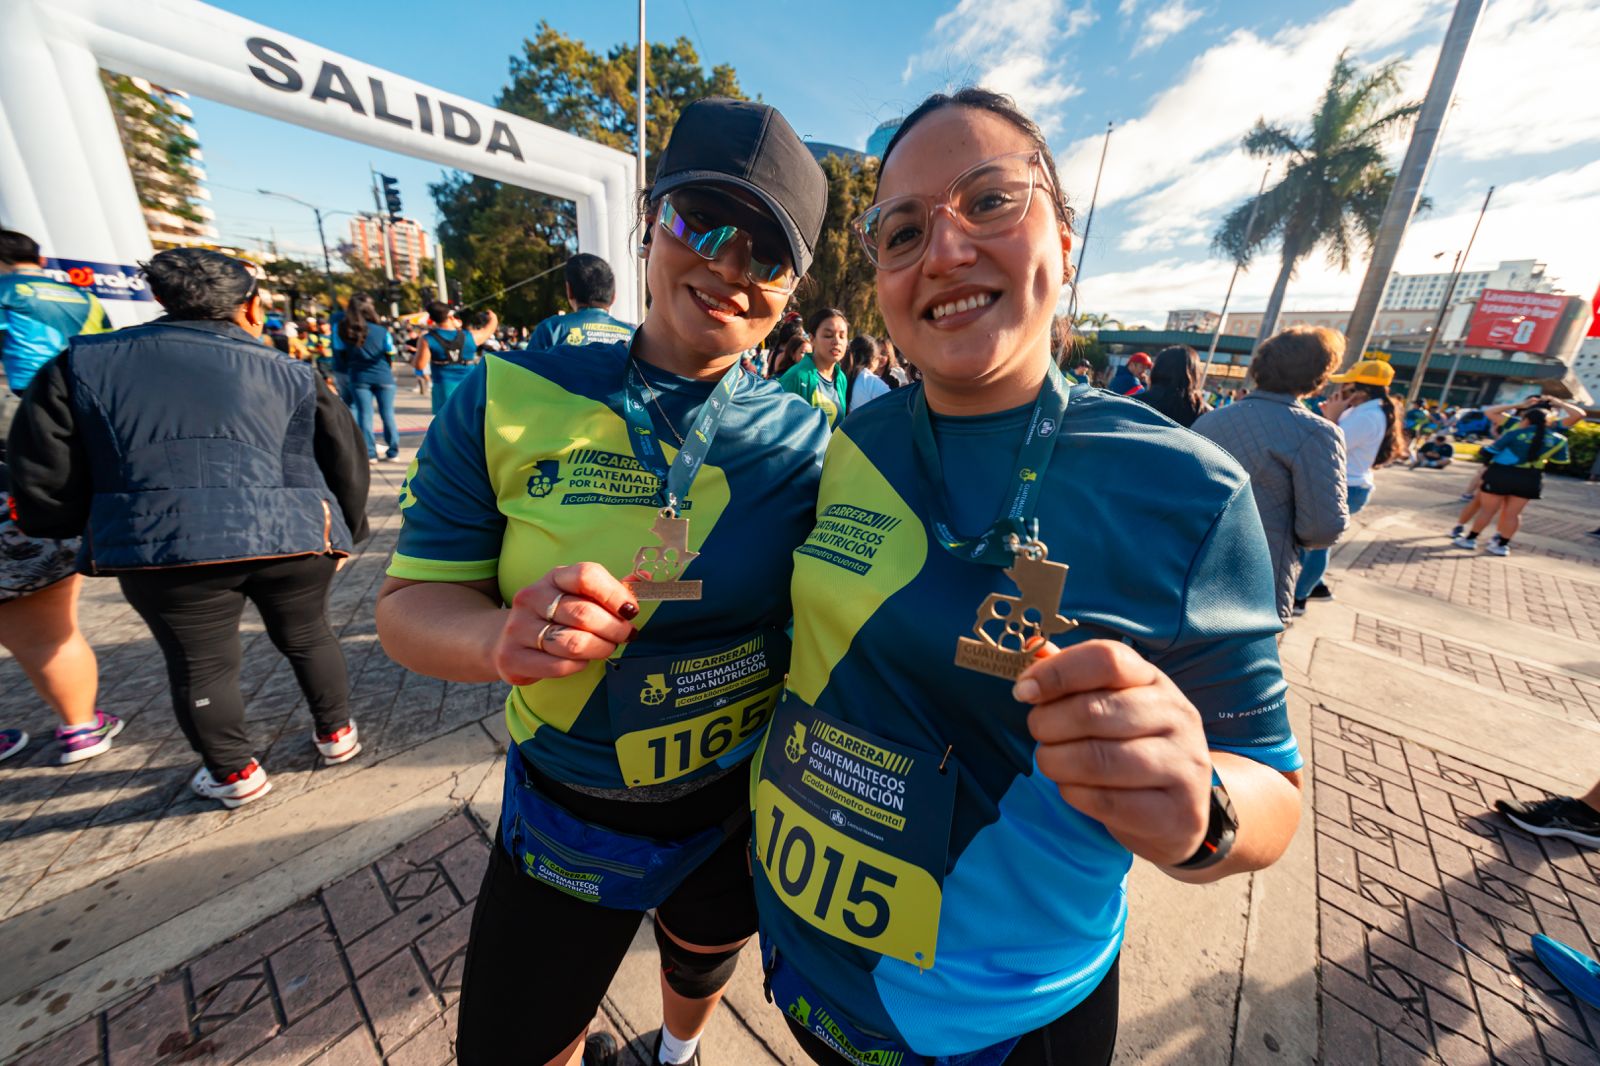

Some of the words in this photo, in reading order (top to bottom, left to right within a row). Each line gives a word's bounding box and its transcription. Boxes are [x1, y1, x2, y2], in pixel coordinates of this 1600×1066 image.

[246, 36, 526, 163] SALIDA
[569, 479, 591, 488] POR
[594, 481, 607, 490] LA
[572, 467, 663, 486] GUATEMALTE
[565, 494, 598, 504] ¡Cada
[599, 494, 650, 504] kilómetro
[828, 506, 874, 524] CARRERA
[816, 531, 878, 559] NUTRICIÓN
[833, 555, 869, 573] cuenta!
[676, 651, 765, 685] GUATEMALTECOS
[692, 645, 747, 669] CARRERA
[678, 686, 695, 694] POR
[696, 682, 707, 690] LA
[708, 660, 766, 687] NUTRICIÓN
[1238, 702, 1280, 718] PROGRAMA
[648, 697, 770, 780] 1165
[828, 731, 884, 765] CARRERA
[811, 742, 906, 794] GUATEMALTECOS
[808, 757, 822, 771] POR
[823, 764, 833, 778] LA
[833, 769, 904, 811] NUTRICIÓN
[803, 774, 825, 790] ¡Cada
[825, 786, 864, 811] kilómetro
[864, 808, 903, 828] cuenta!
[539, 865, 599, 891] GUATEMALTECOS
[550, 863, 587, 879] CARRERA
[766, 804, 898, 939] 1015
[831, 1025, 880, 1063] CARRERA
